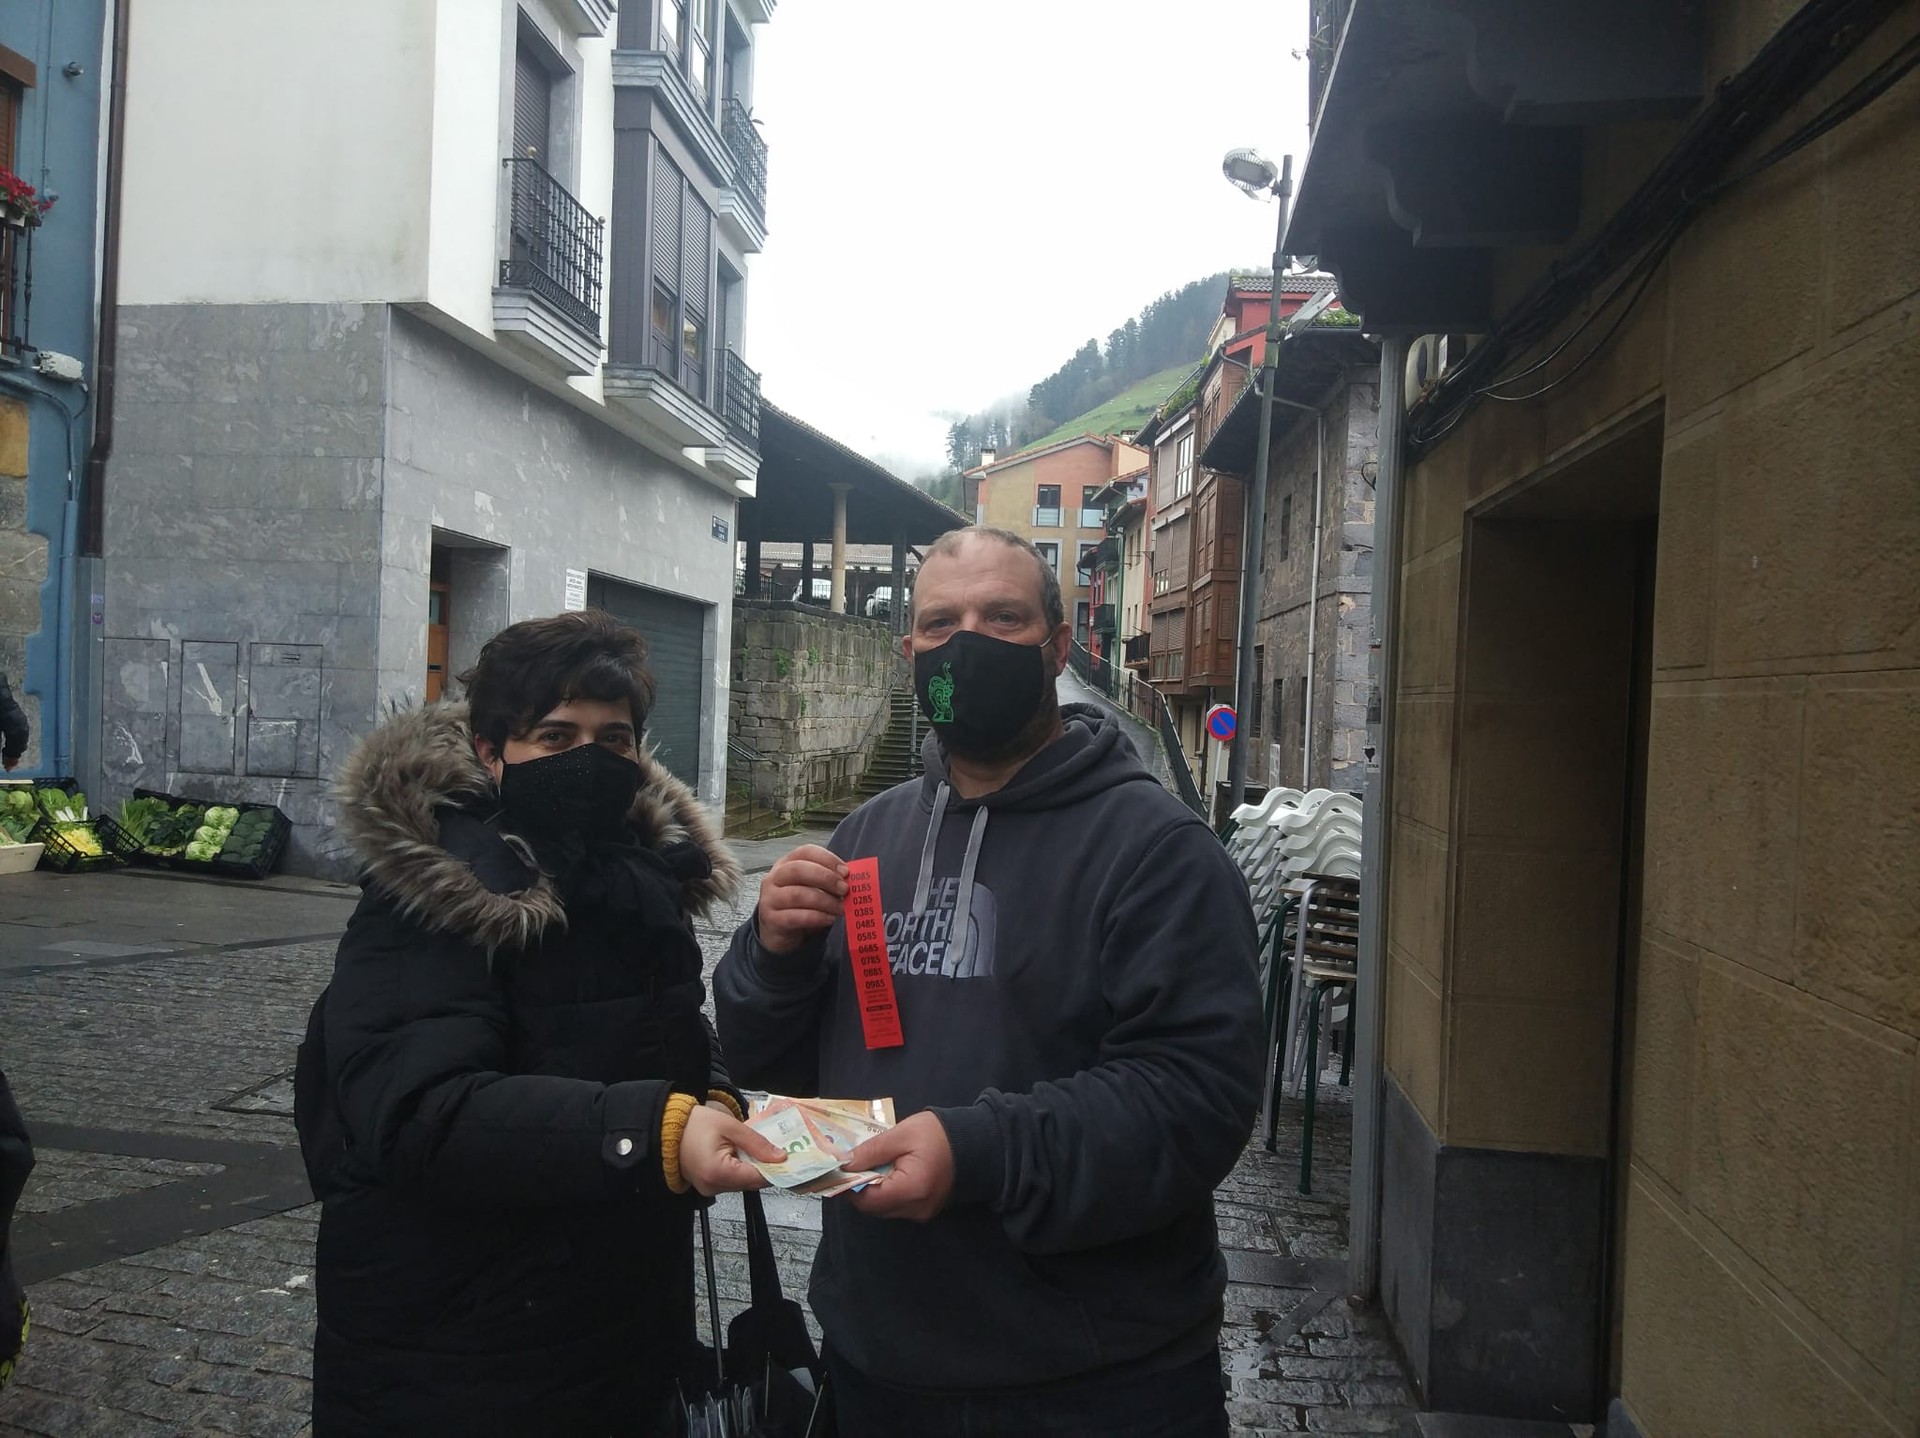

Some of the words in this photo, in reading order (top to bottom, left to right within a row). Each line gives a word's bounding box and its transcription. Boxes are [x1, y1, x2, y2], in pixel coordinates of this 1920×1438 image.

[851, 872, 870, 881] 0085
[929, 877, 961, 909] HE
[853, 895, 873, 905] 0285
[854, 907, 874, 917] 0385
[856, 920, 875, 930] 0485
[883, 909, 952, 942] ORTH
[857, 932, 877, 941] 0585
[859, 944, 878, 953] 0685
[861, 955, 881, 965] 0785
[887, 941, 944, 976] FACE
[863, 968, 883, 977] 0885
[865, 979, 885, 989] 0985
